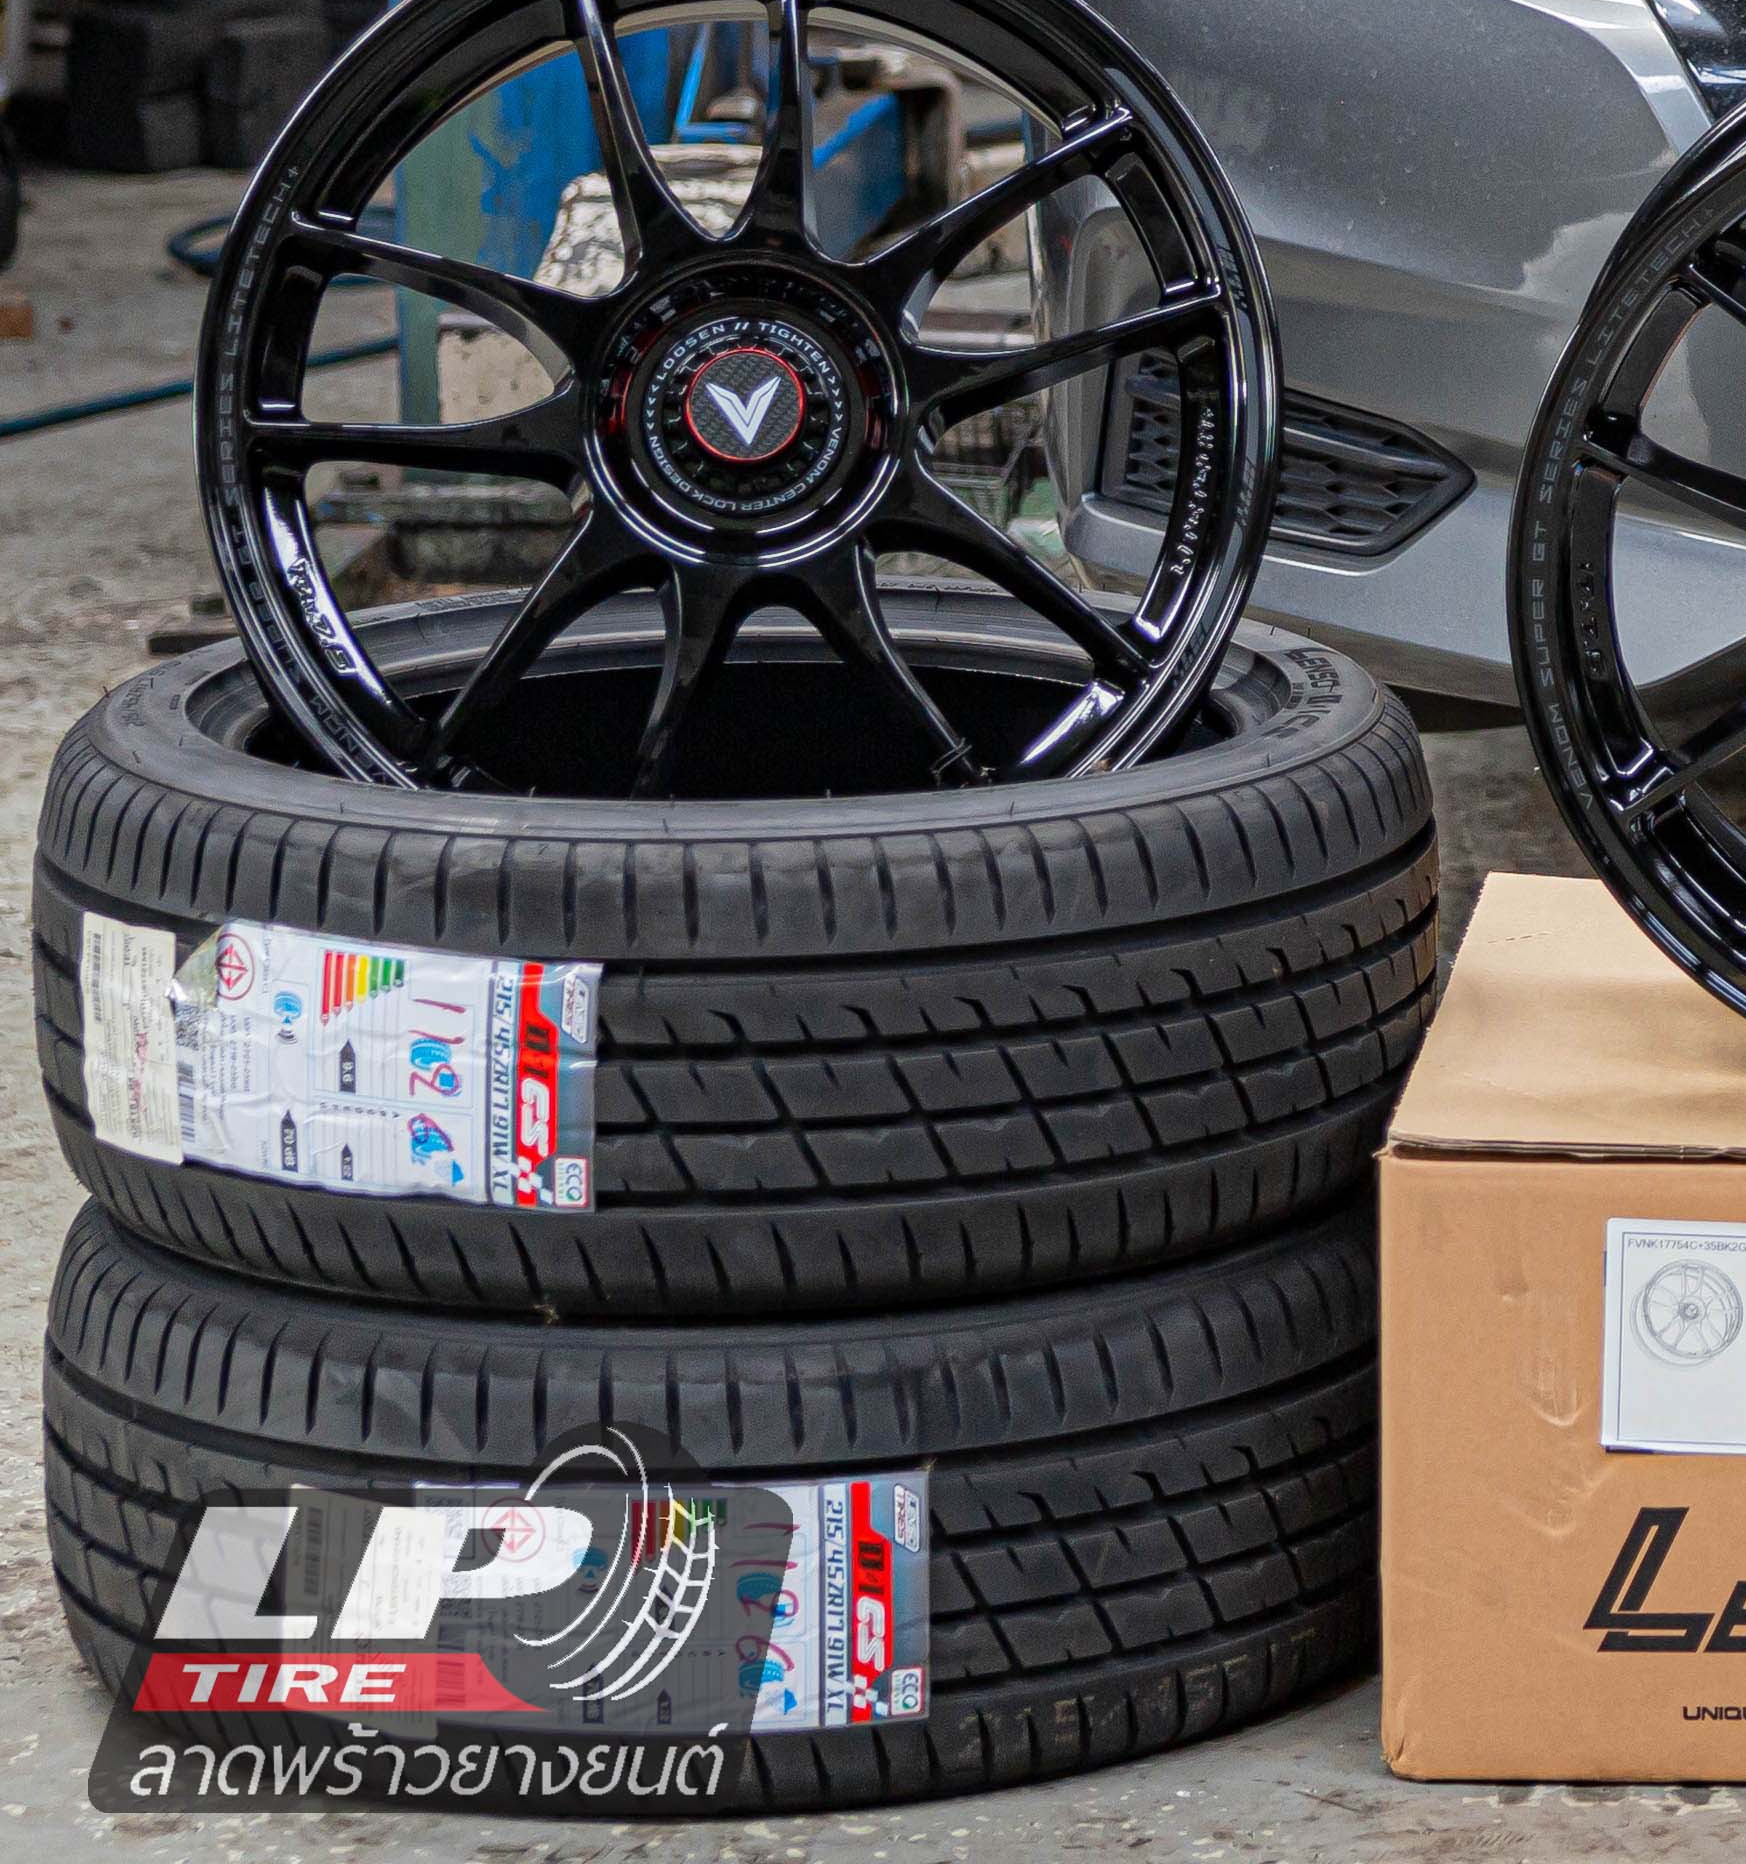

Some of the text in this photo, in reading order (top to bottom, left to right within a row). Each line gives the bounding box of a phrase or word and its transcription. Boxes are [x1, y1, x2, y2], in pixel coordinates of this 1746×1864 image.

[649, 322, 842, 512] LOOSEN TIGHTEN VENOM CENTER LOCK DESIGN
[1540, 381, 1586, 503] SERIES
[1528, 578, 1553, 686] SUPER
[1549, 704, 1594, 810] VENOM
[825, 1499, 846, 1713] 215/45ZR17 91W XL
[903, 1672, 919, 1708] ECO
